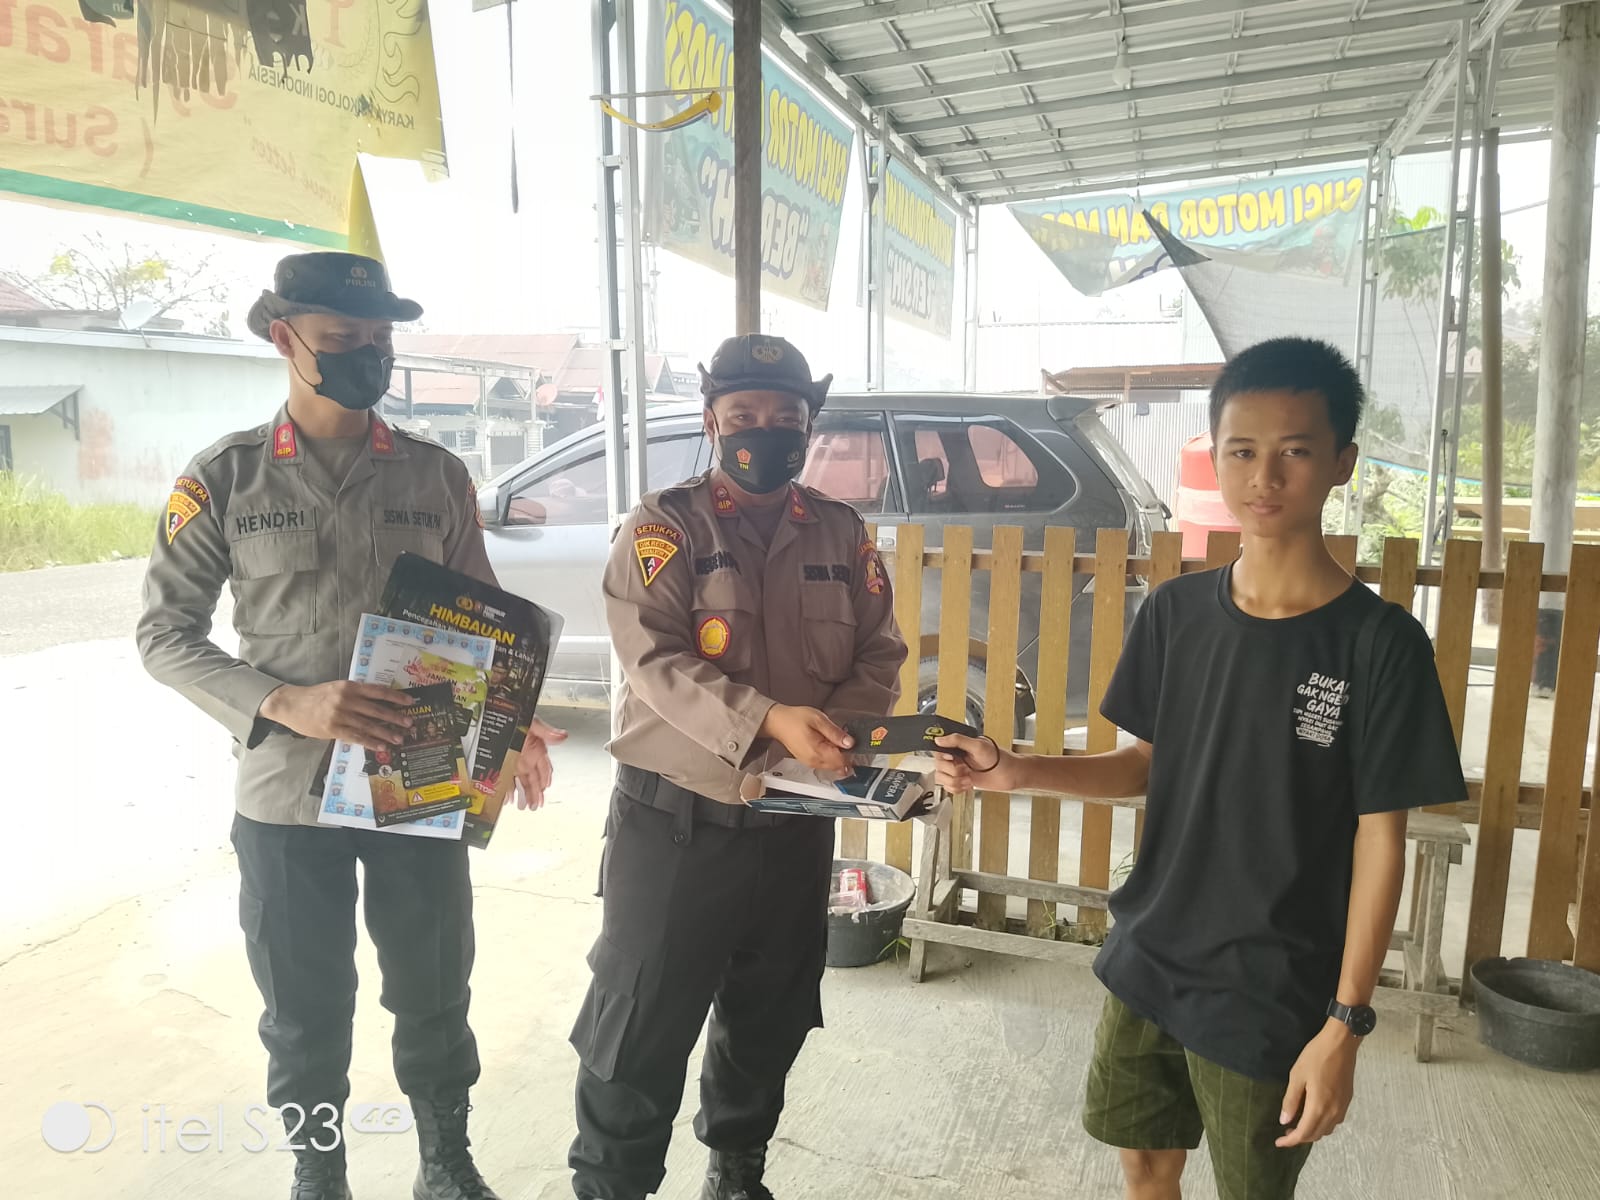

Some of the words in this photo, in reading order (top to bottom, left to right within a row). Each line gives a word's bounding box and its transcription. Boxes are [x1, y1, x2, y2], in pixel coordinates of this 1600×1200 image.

[236, 510, 305, 535] HENDRI
[636, 524, 678, 540] SETUKPA
[647, 557, 657, 568] A
[429, 603, 516, 646] HIMBAUAN
[1296, 683, 1320, 699] GAK
[1306, 699, 1341, 719] GAYA
